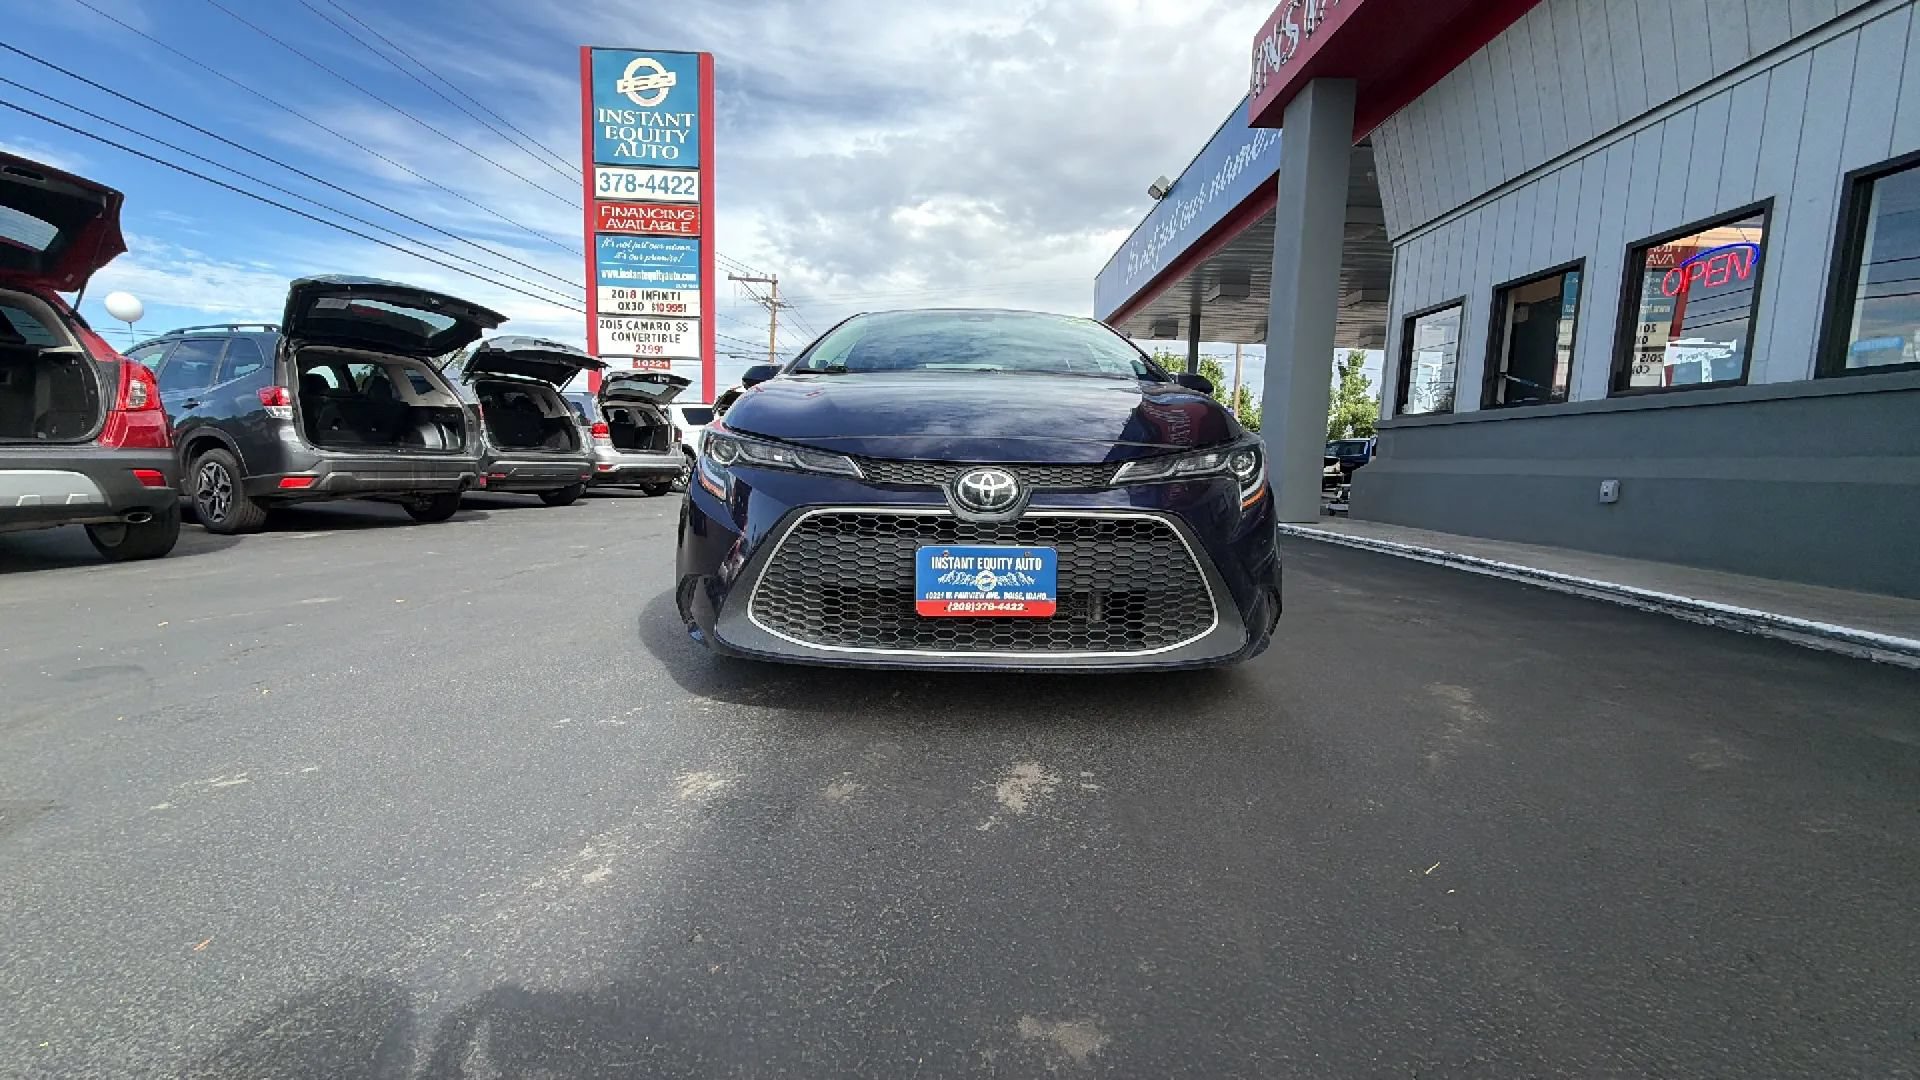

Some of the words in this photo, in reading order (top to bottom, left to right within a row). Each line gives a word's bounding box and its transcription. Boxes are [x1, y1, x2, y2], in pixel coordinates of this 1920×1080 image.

[598, 108, 695, 127] INSTANT
[605, 125, 690, 144] EQUITY
[614, 142, 679, 160] AUTO
[600, 172, 695, 195] 378-4422
[601, 205, 695, 220] FINANCING
[605, 218, 692, 232] AVAILABLE
[1663, 246, 1753, 297] OPEN
[599, 319, 623, 329] 2015
[626, 320, 671, 331] CAMARO
[675, 322, 689, 333] SS
[611, 331, 681, 344] CONVERTIBLE
[931, 556, 974, 570] INSTANT
[977, 557, 1013, 571] EQUITY
[1015, 557, 1043, 571] AUTO
[954, 591, 985, 600] FAIRVIEW
